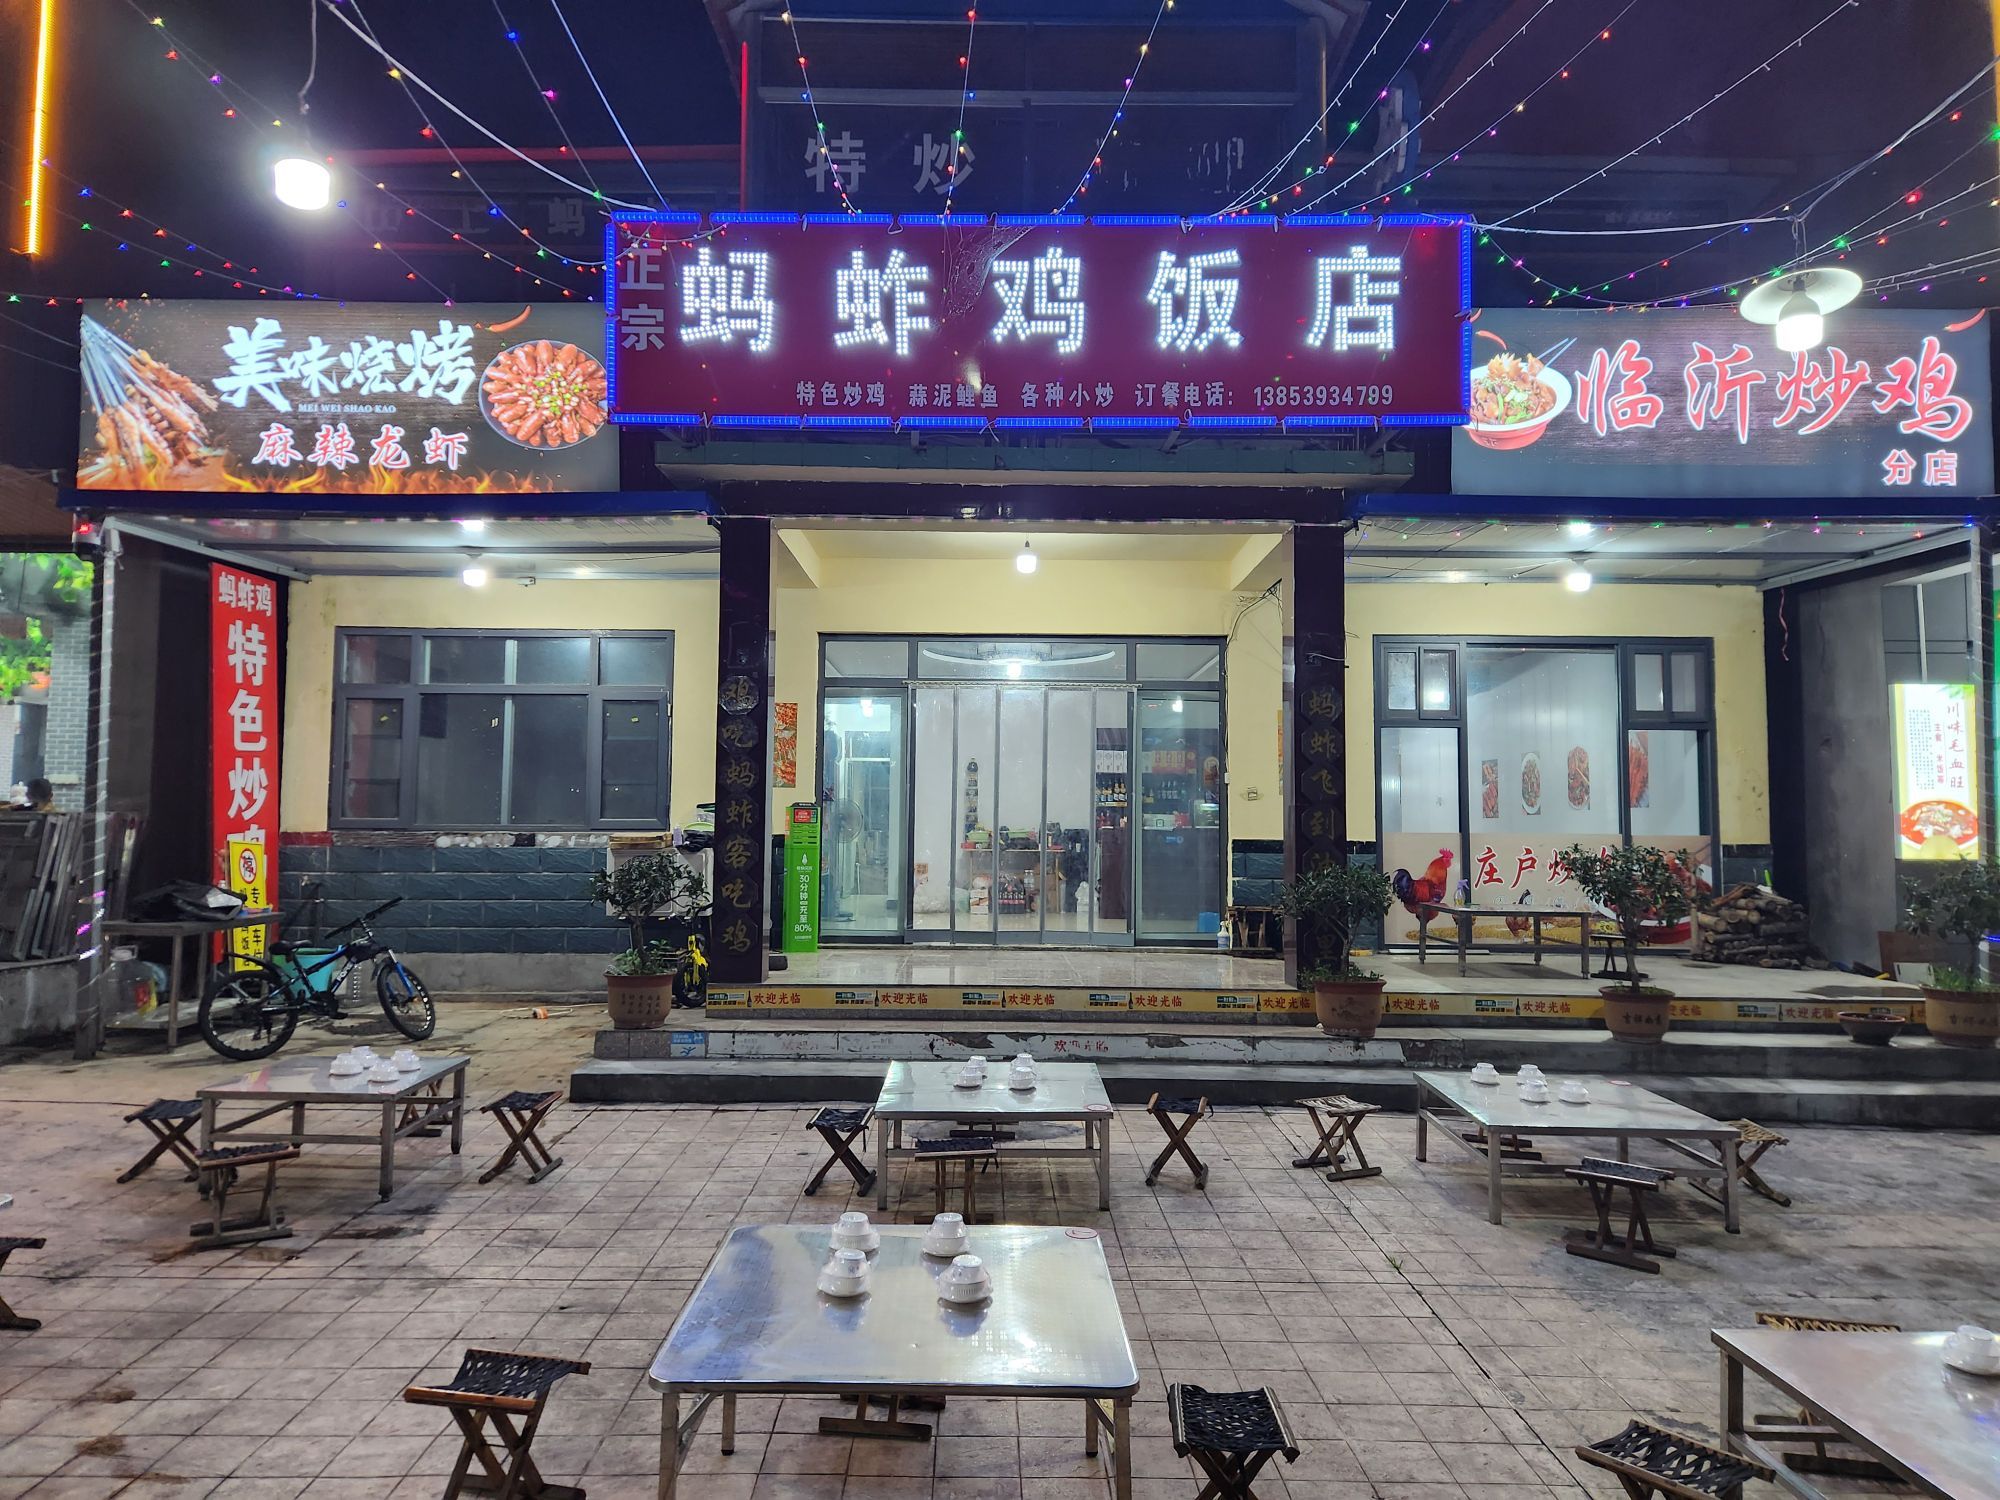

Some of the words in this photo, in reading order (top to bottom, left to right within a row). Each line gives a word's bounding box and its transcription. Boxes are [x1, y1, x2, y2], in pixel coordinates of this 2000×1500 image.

[618, 246, 666, 353] 正宗
[679, 246, 1403, 355] 蚂蚱鸡饭店
[212, 316, 480, 413] 美味烧烤
[796, 381, 886, 407] 特色炒鸡
[908, 383, 999, 408] 蒜泥鲤鱼
[1020, 382, 1114, 408] 各种小炒
[1254, 384, 1394, 407] 13853934799
[1575, 336, 1973, 444] 临沂炒鸡
[298, 404, 318, 413] MEI
[321, 404, 342, 413] WEI
[343, 404, 373, 413] SHAO
[375, 404, 397, 413] KAO
[252, 423, 469, 471] 麻辣龙虾
[1883, 450, 1959, 487] 分店
[218, 571, 272, 617] 蚂蚱鸡
[1473, 845, 1612, 890] 庄户炒
[753, 991, 801, 1006] 欢迎光临
[880, 991, 928, 1006] 欢迎光临
[1007, 993, 1055, 1007] 欢迎光临
[1135, 994, 1182, 1008] 欢迎光临
[1262, 994, 1311, 1009] 欢迎光临
[1391, 998, 1440, 1012] 欢迎光临
[1522, 1000, 1571, 1014] 欢迎光临
